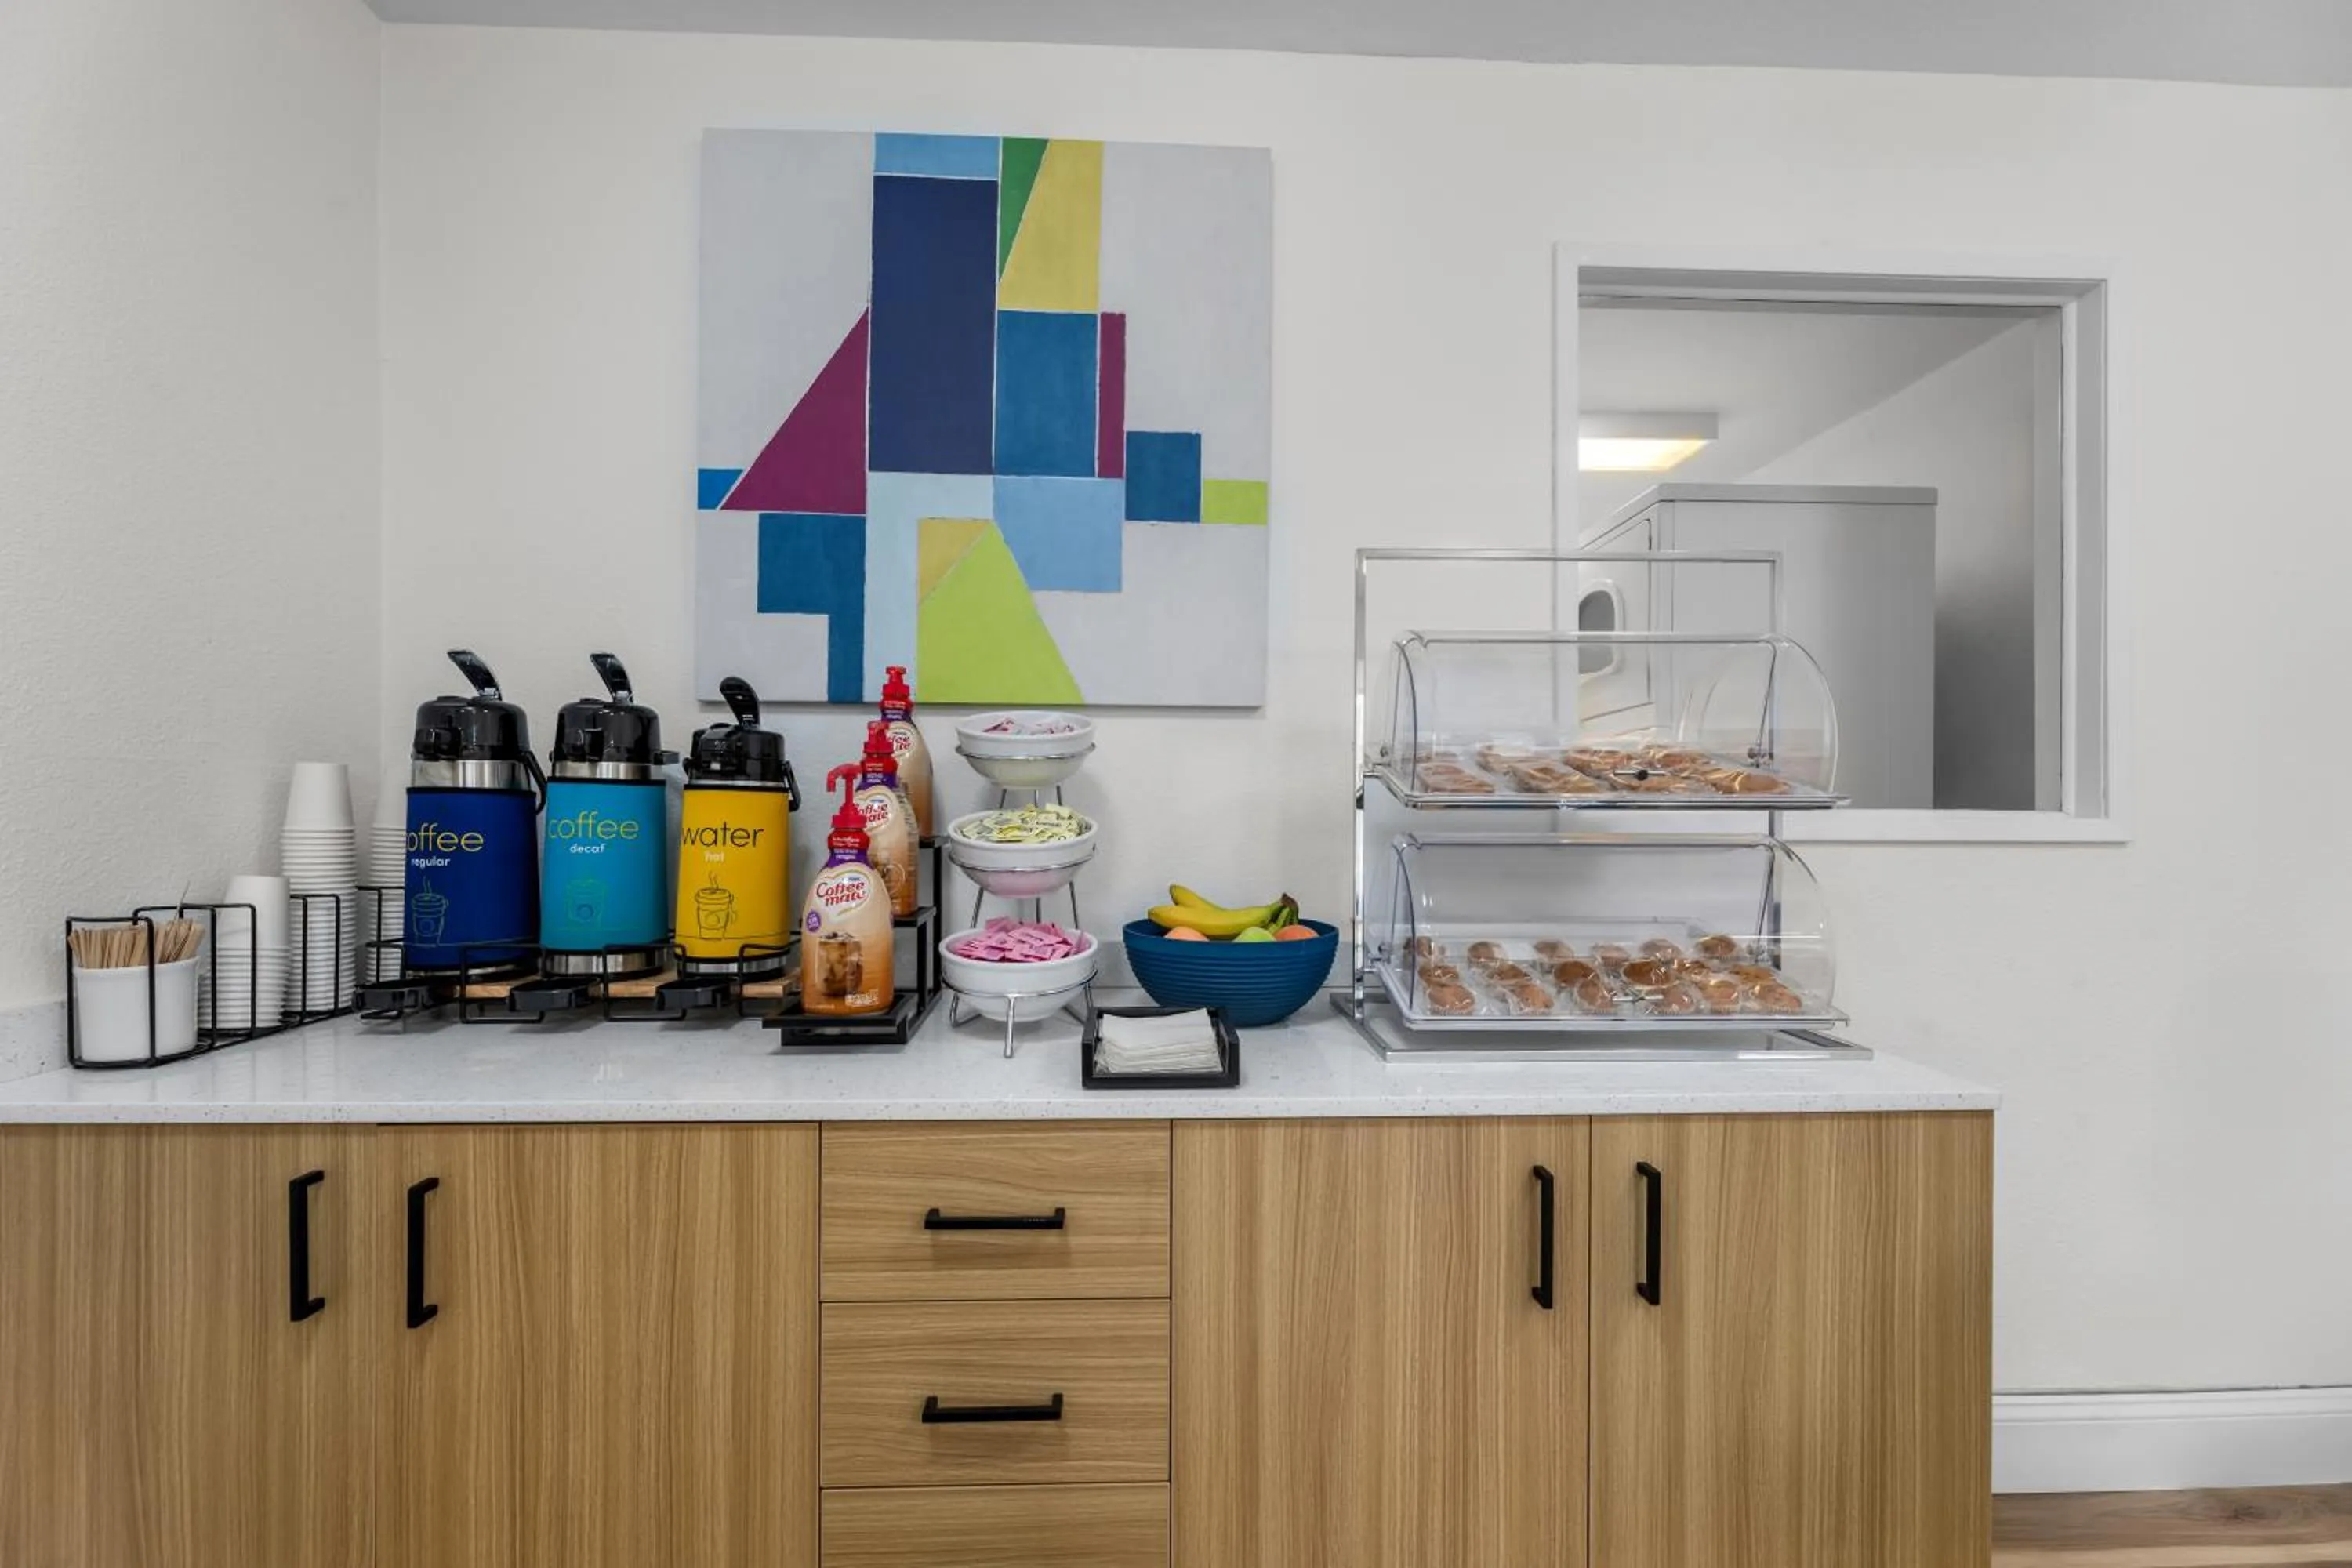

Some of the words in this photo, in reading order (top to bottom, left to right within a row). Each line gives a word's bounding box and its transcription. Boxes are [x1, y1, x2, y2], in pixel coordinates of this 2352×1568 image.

[855, 802, 888, 816] offee
[866, 811, 888, 822] ate
[549, 811, 640, 840] coffee
[681, 820, 765, 848] water
[407, 822, 484, 852] offee
[570, 843, 607, 854] decaf
[411, 855, 451, 869] regular
[816, 881, 866, 898] Coffee
[825, 889, 867, 906] mate
